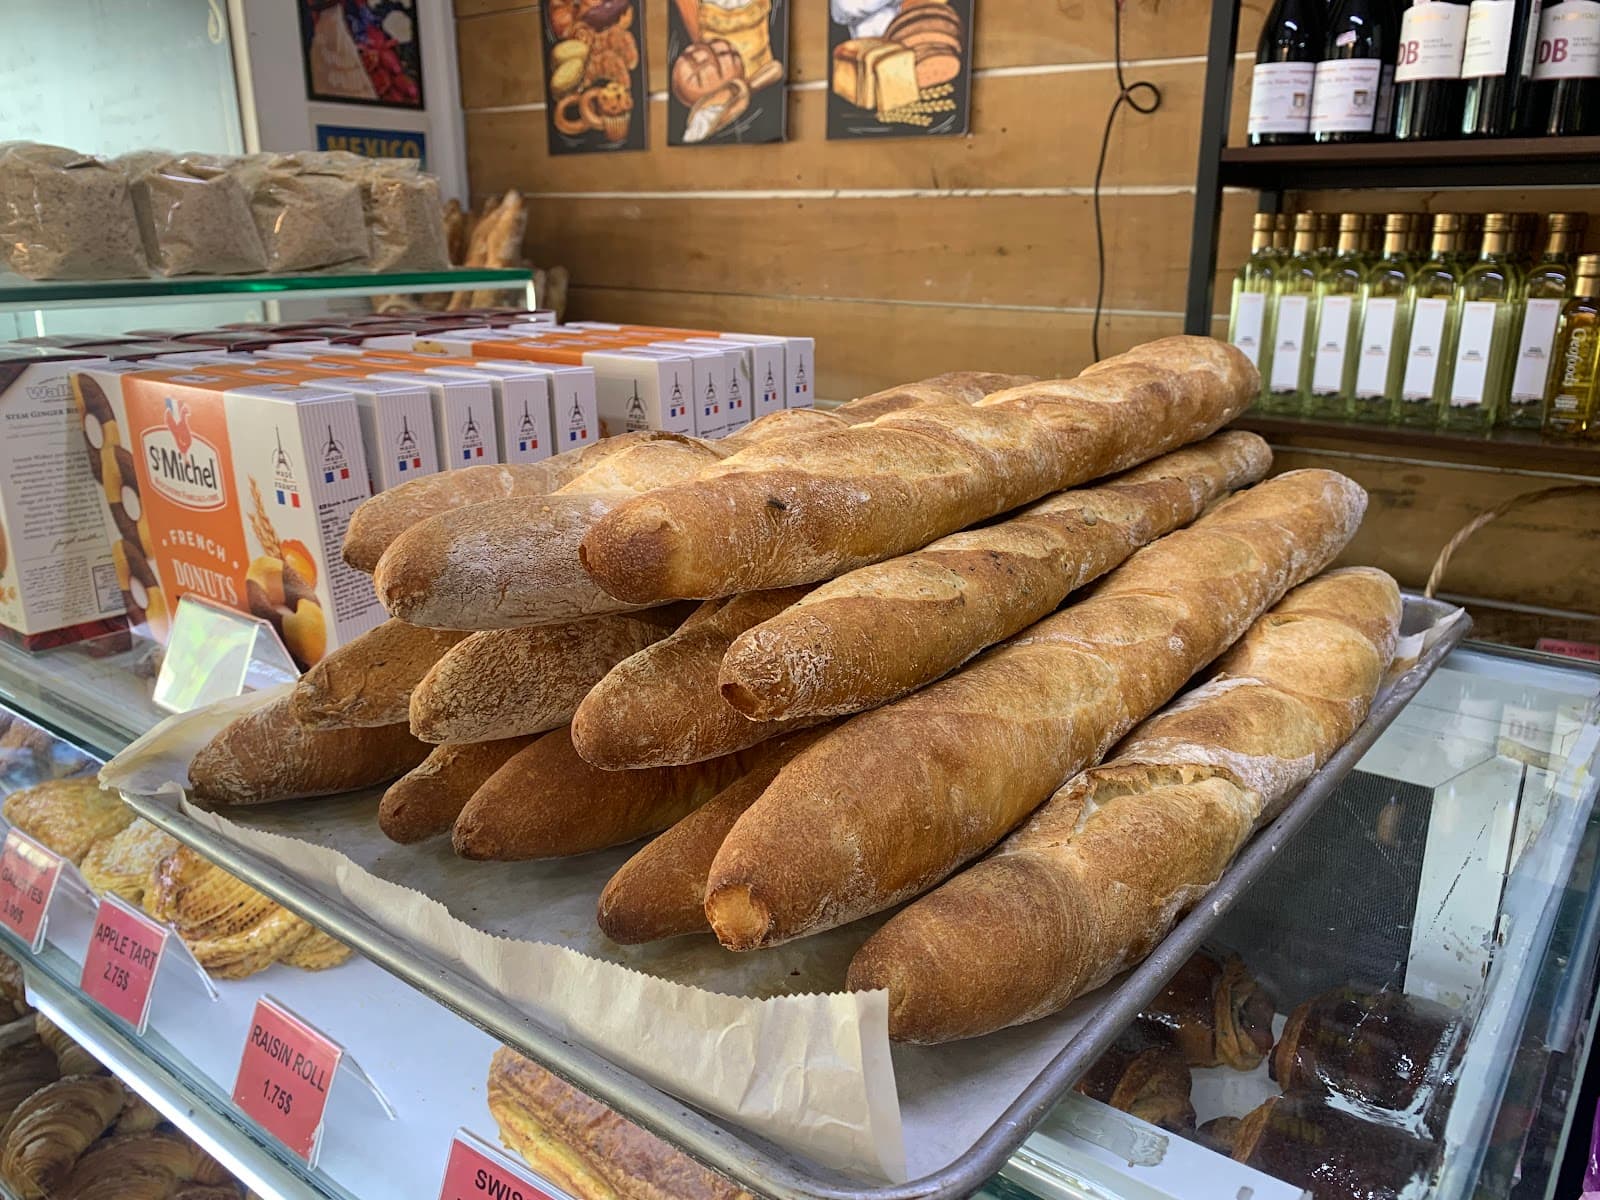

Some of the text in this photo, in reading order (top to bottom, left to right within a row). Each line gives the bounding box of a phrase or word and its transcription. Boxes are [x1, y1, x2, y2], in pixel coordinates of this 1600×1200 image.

[161, 447, 218, 490] Michel
[168, 529, 226, 562] FRENCH
[172, 559, 238, 605] DONUTS
[95, 922, 159, 970] APPLE TART
[251, 1025, 325, 1093] RAISIN ROLL
[263, 1079, 293, 1115] 1.75$
